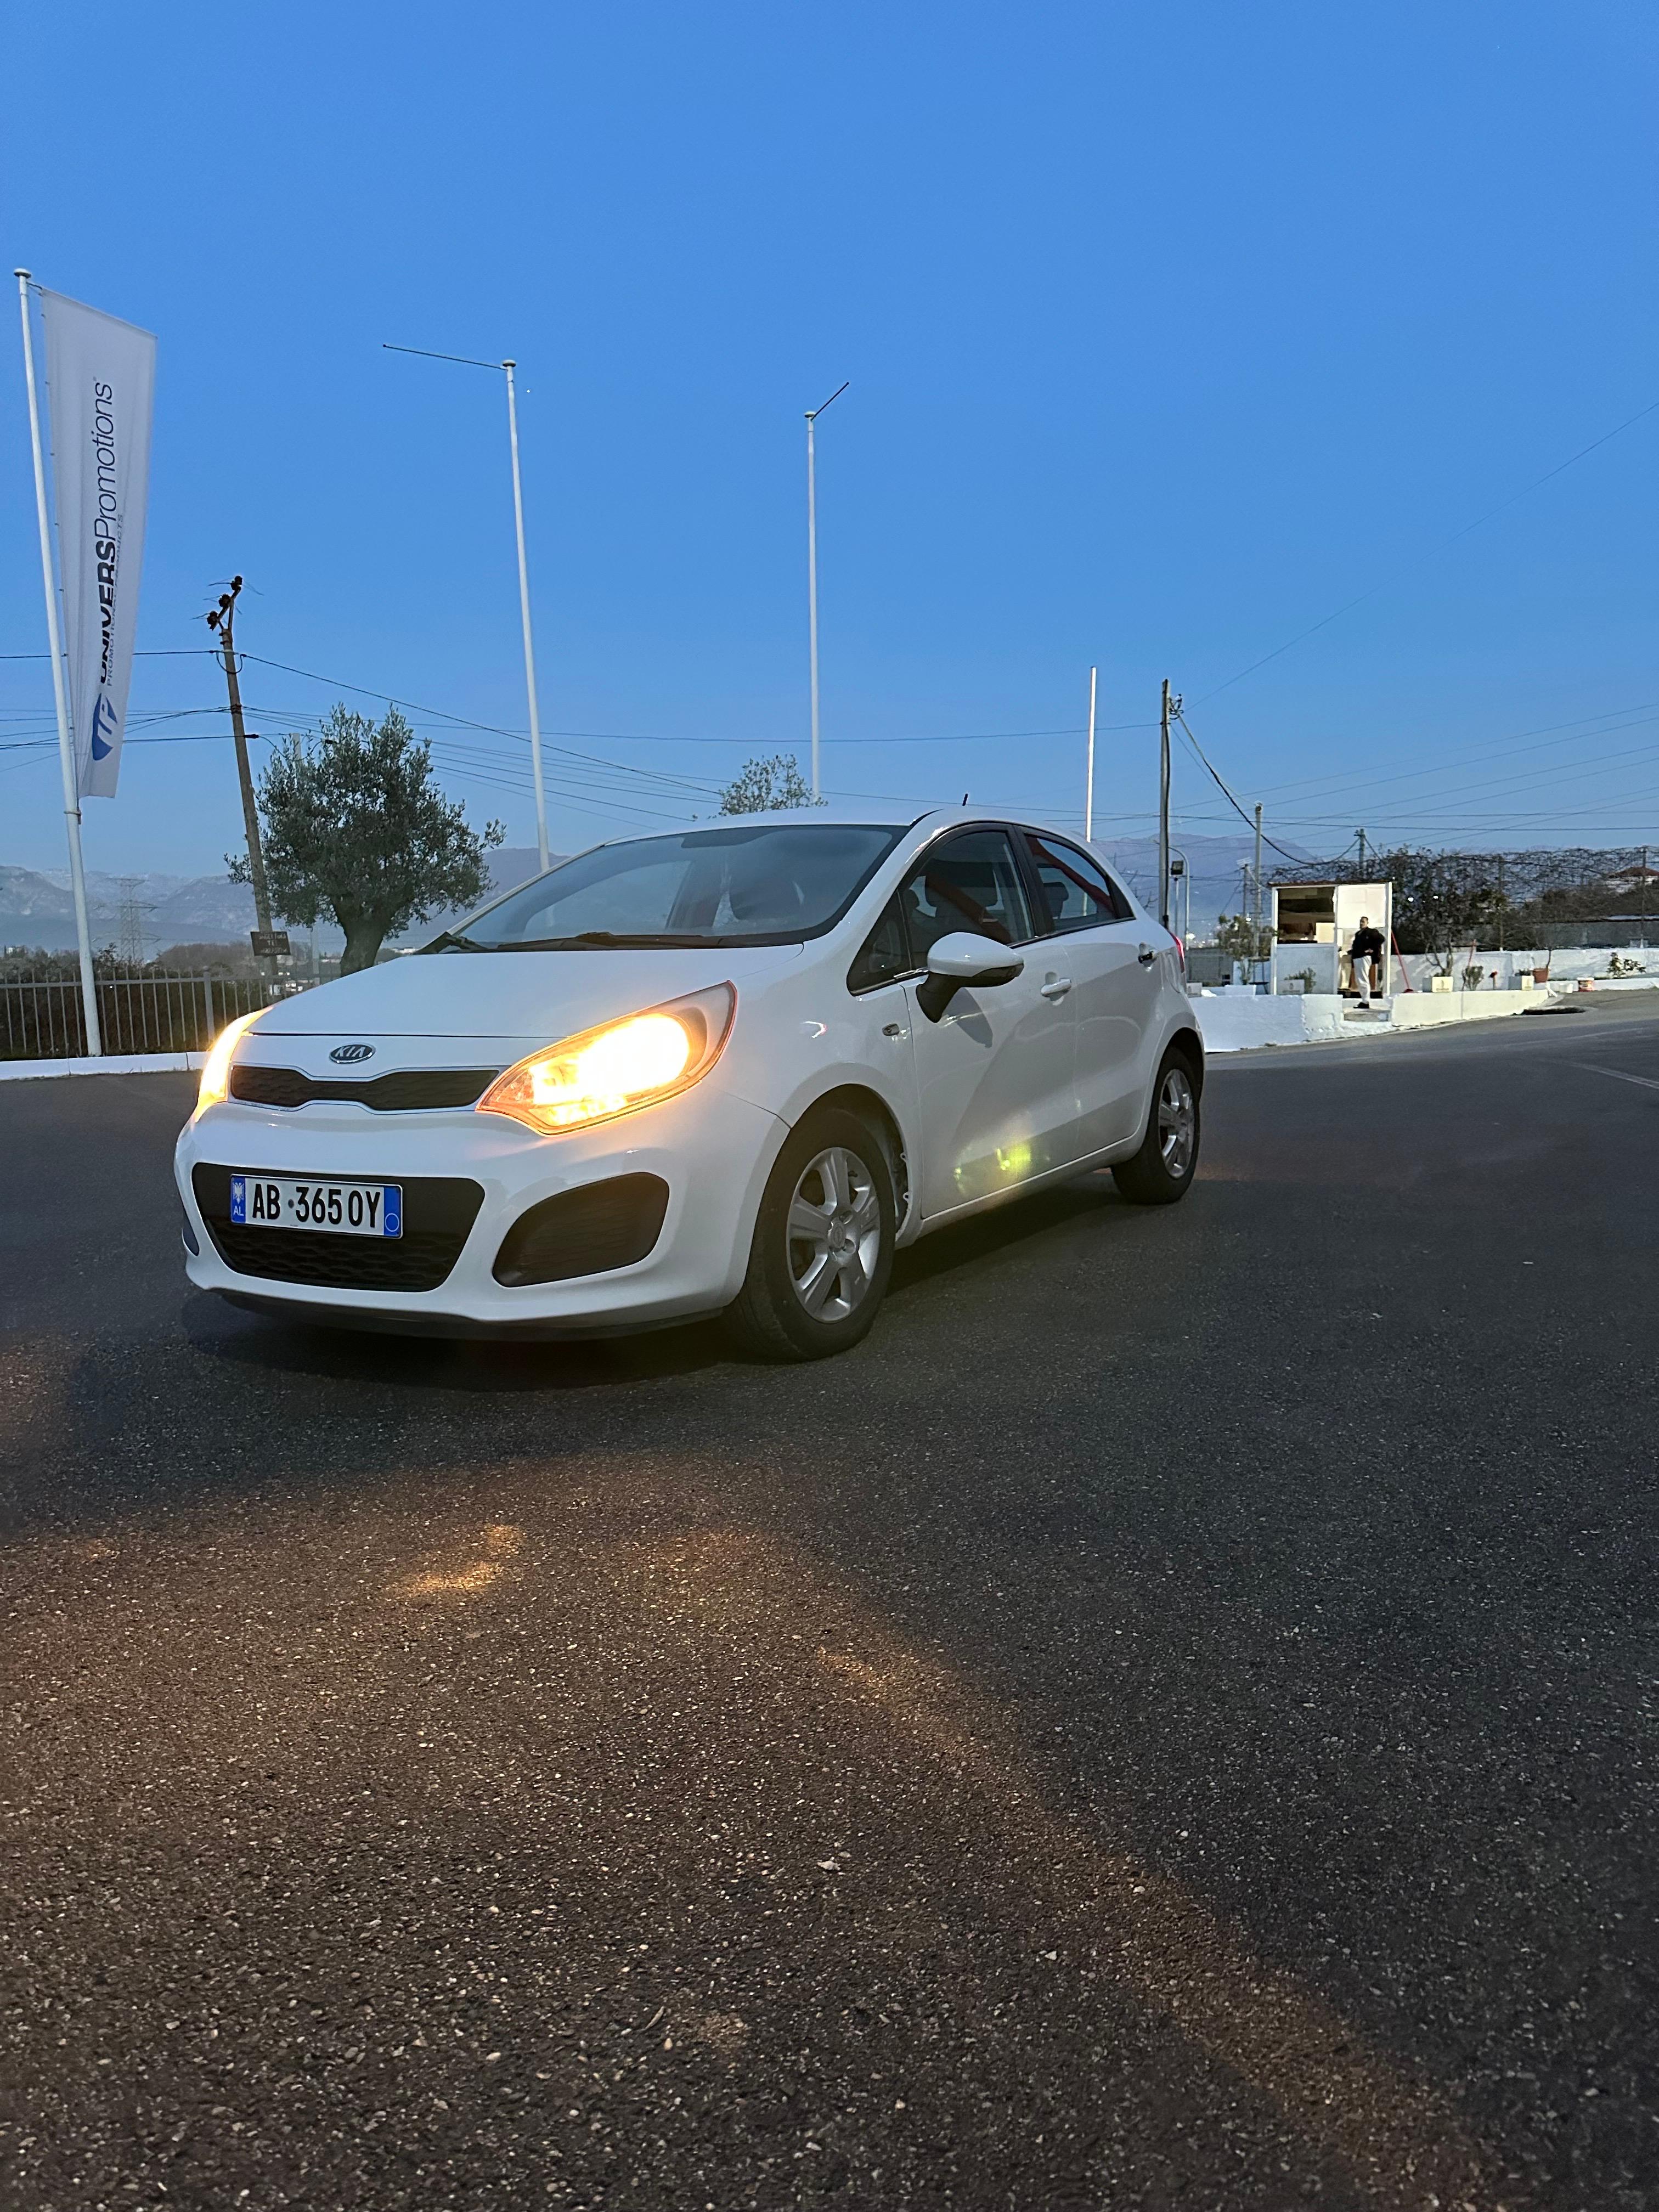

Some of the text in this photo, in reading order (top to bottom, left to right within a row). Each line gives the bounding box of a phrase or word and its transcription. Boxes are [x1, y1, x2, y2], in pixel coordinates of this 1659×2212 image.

[335, 1046, 366, 1058] KIA
[252, 1183, 280, 1220] AB
[233, 1205, 245, 1216] AL
